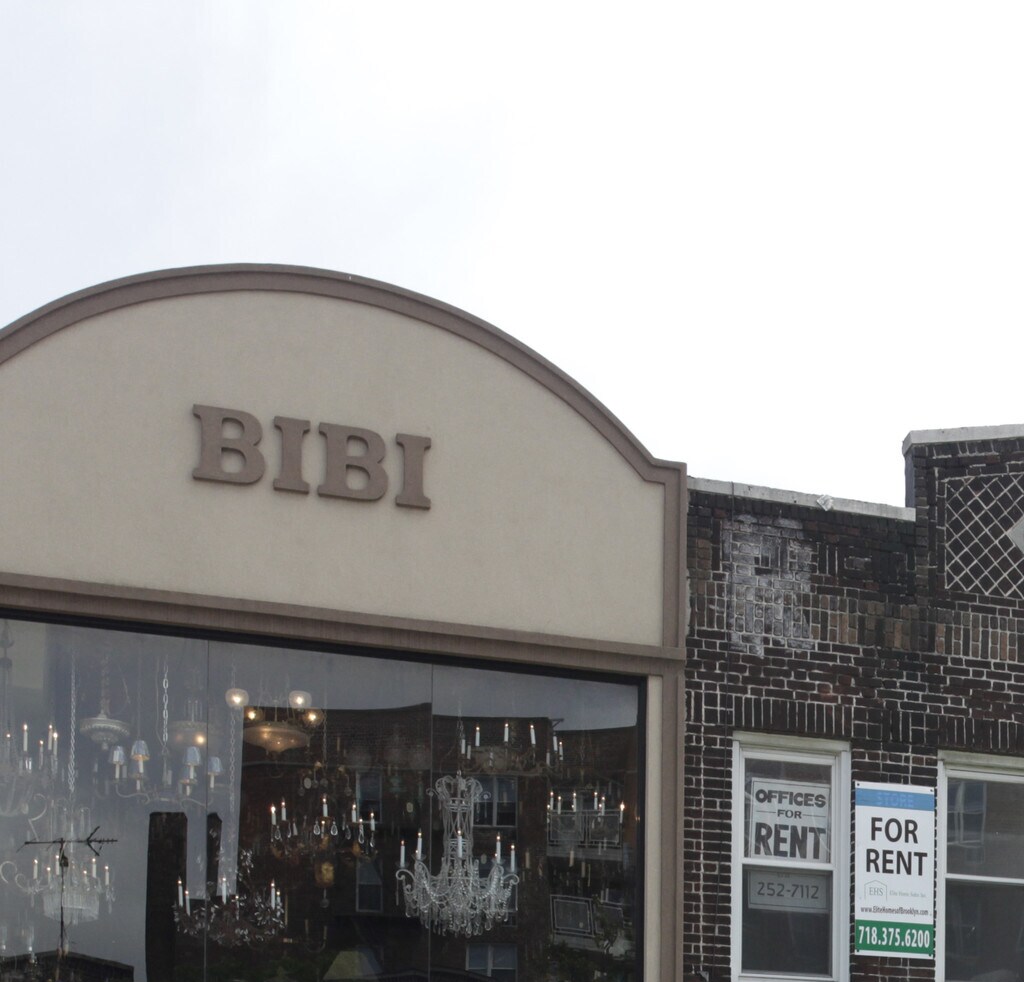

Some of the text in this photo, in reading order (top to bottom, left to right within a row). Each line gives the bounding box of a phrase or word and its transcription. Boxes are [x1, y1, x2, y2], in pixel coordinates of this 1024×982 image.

[192, 403, 432, 510] BIBI
[755, 789, 827, 808] OFFICES
[777, 809, 802, 819] FOR
[754, 822, 827, 860] RENT
[871, 817, 918, 844] FOR
[866, 848, 928, 876] RENT
[757, 881, 819, 900] 252-7112
[869, 887, 884, 897] EHS
[858, 926, 930, 948] 718.375.6200
